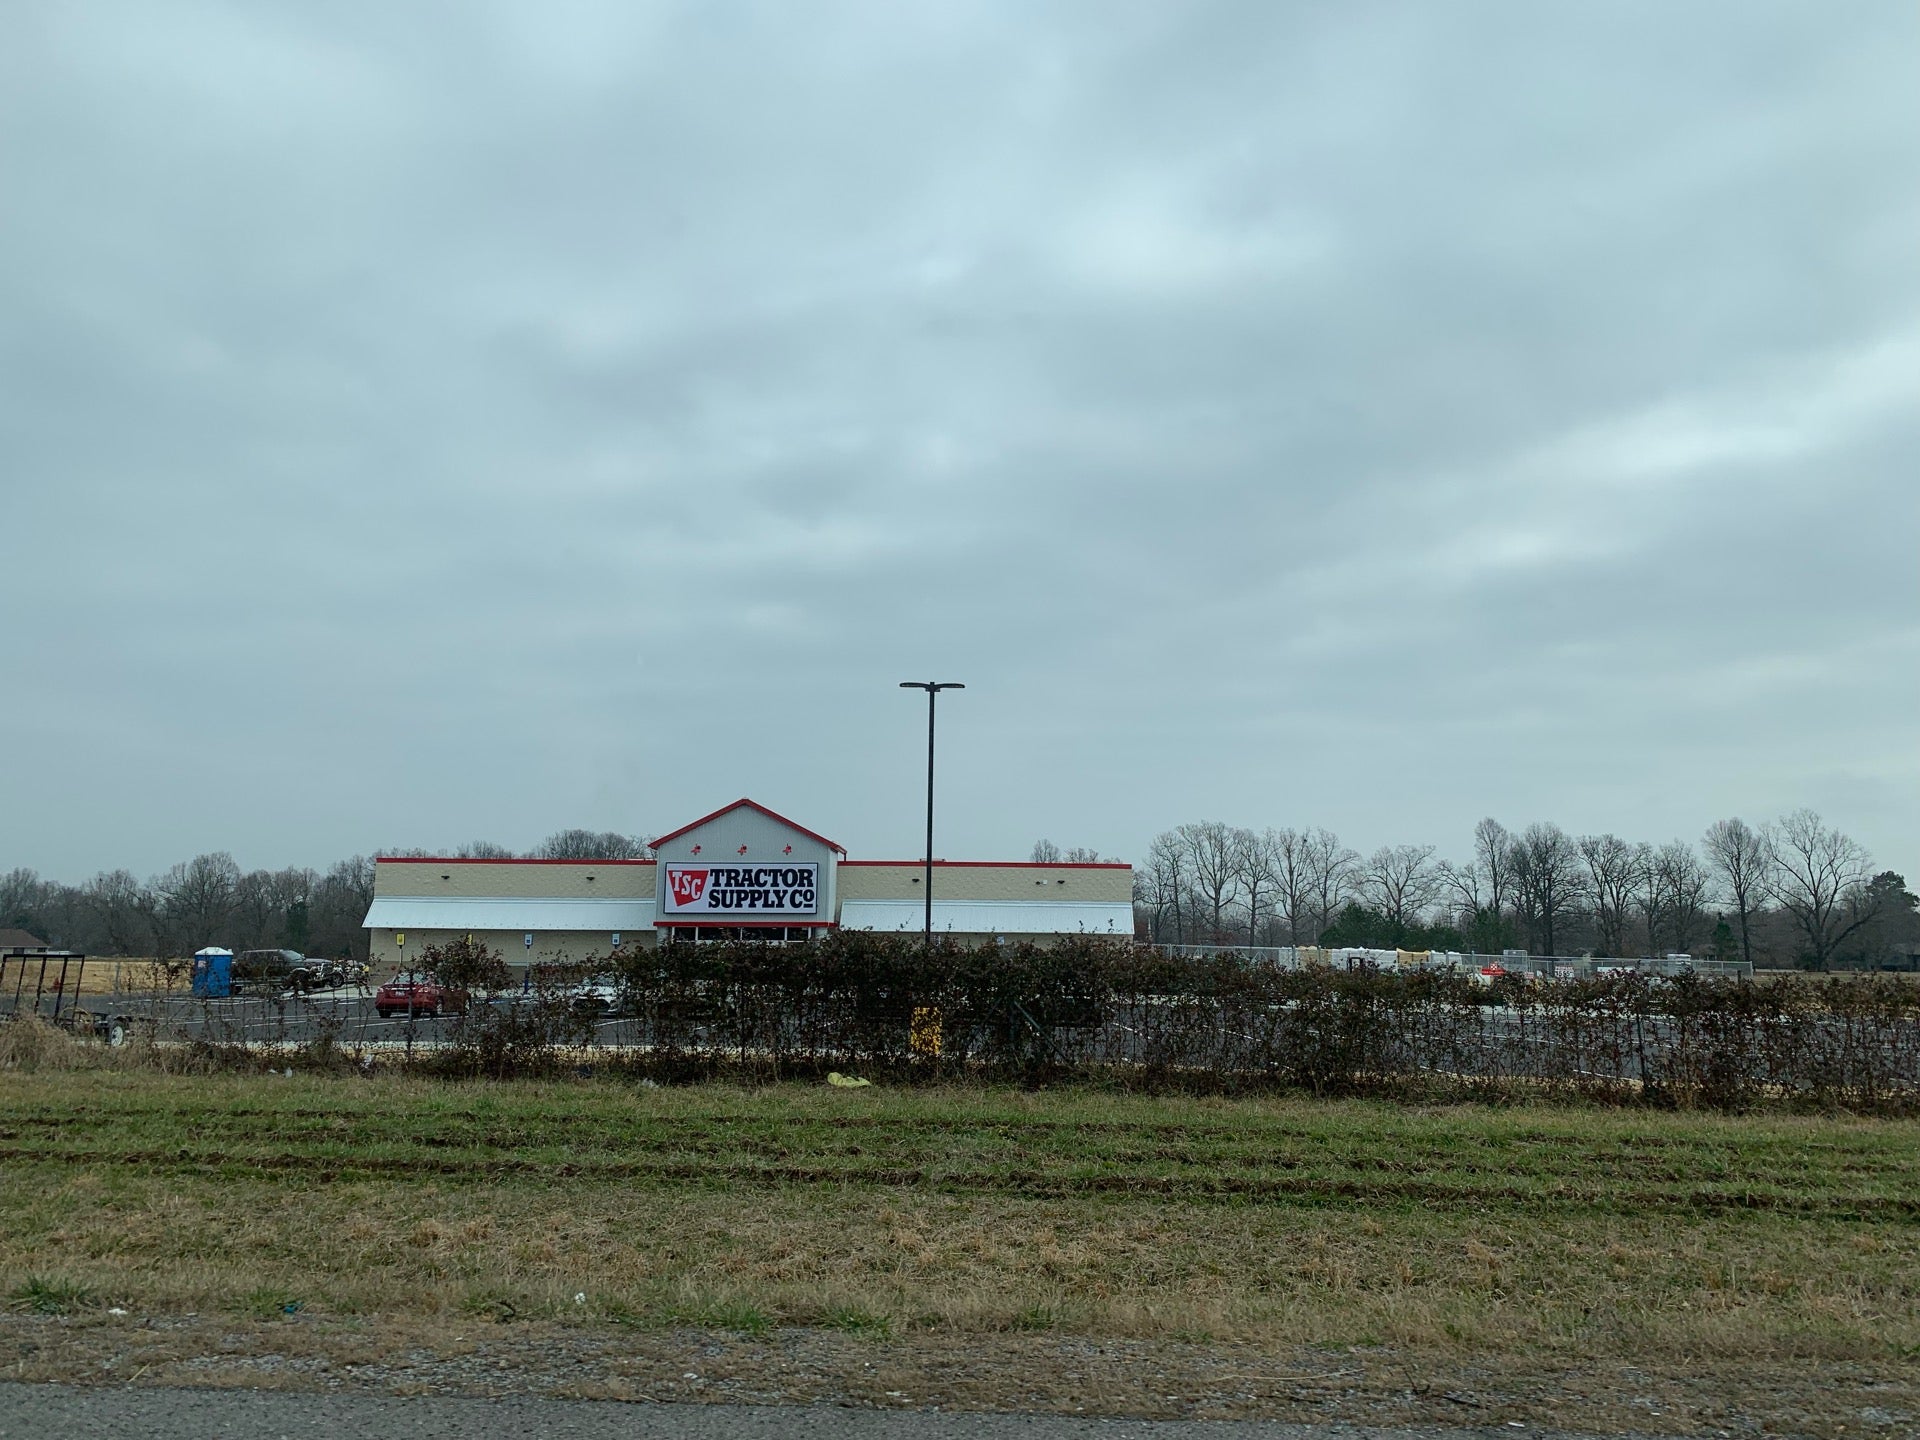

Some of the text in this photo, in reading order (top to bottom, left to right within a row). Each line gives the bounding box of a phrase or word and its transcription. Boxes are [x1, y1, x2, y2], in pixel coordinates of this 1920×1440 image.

[672, 871, 701, 899] TSC
[709, 868, 814, 888] TRACTOR
[708, 889, 788, 908] SUPPLY
